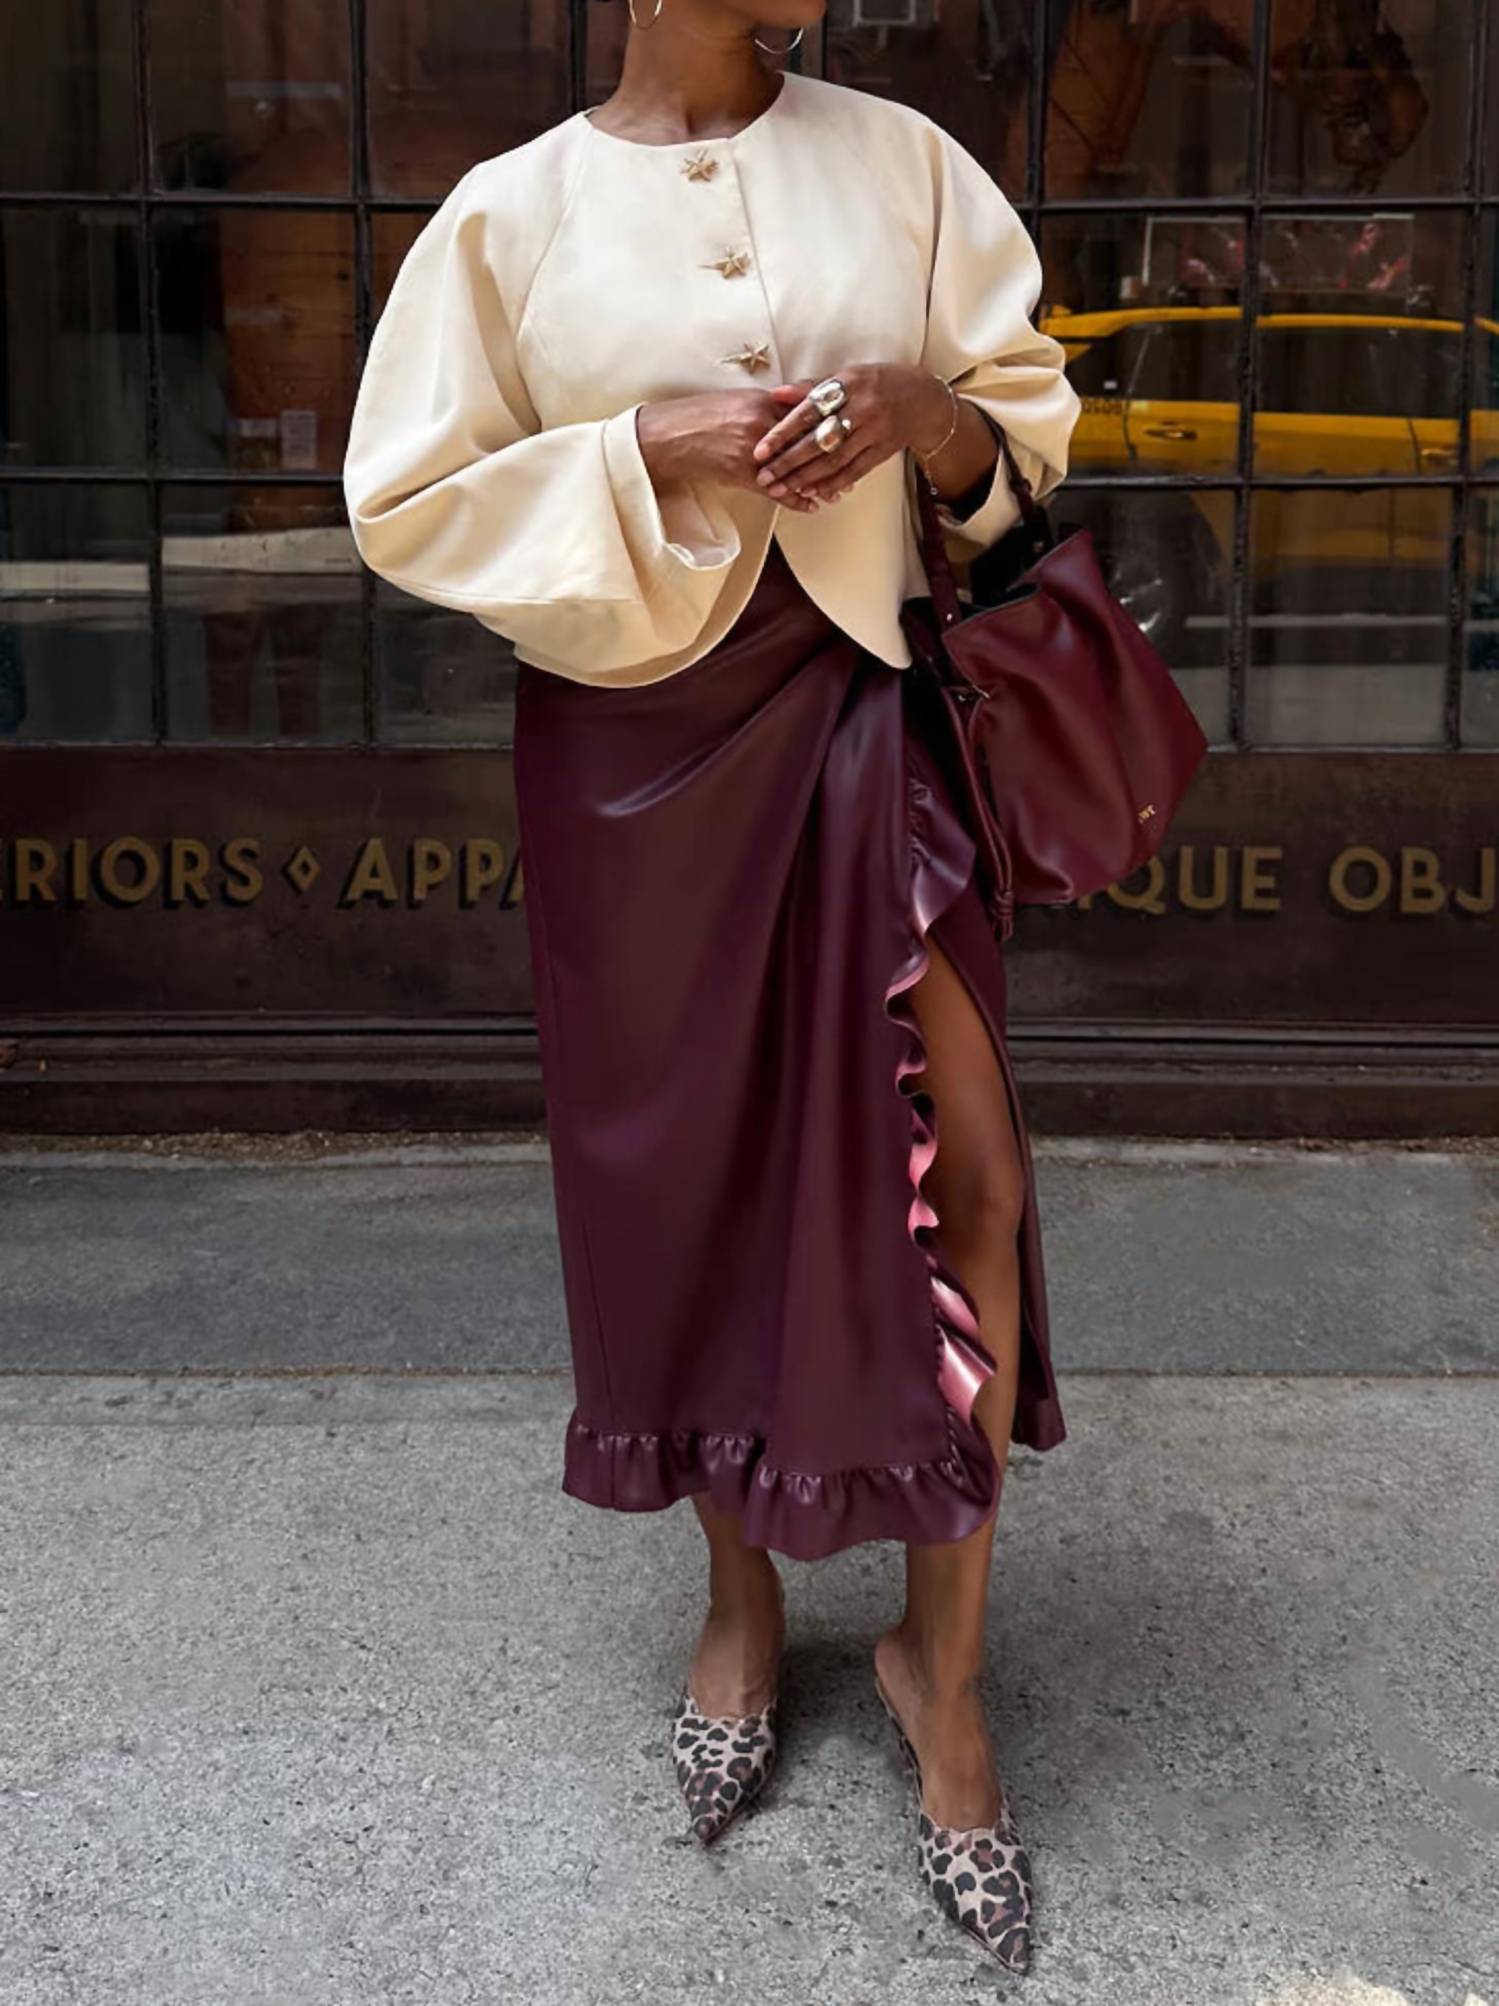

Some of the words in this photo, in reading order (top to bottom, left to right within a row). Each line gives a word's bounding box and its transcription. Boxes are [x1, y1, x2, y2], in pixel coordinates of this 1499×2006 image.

[0, 836, 264, 902] RIORS
[1077, 846, 1283, 914] QUE
[1328, 845, 1496, 913] OBJ
